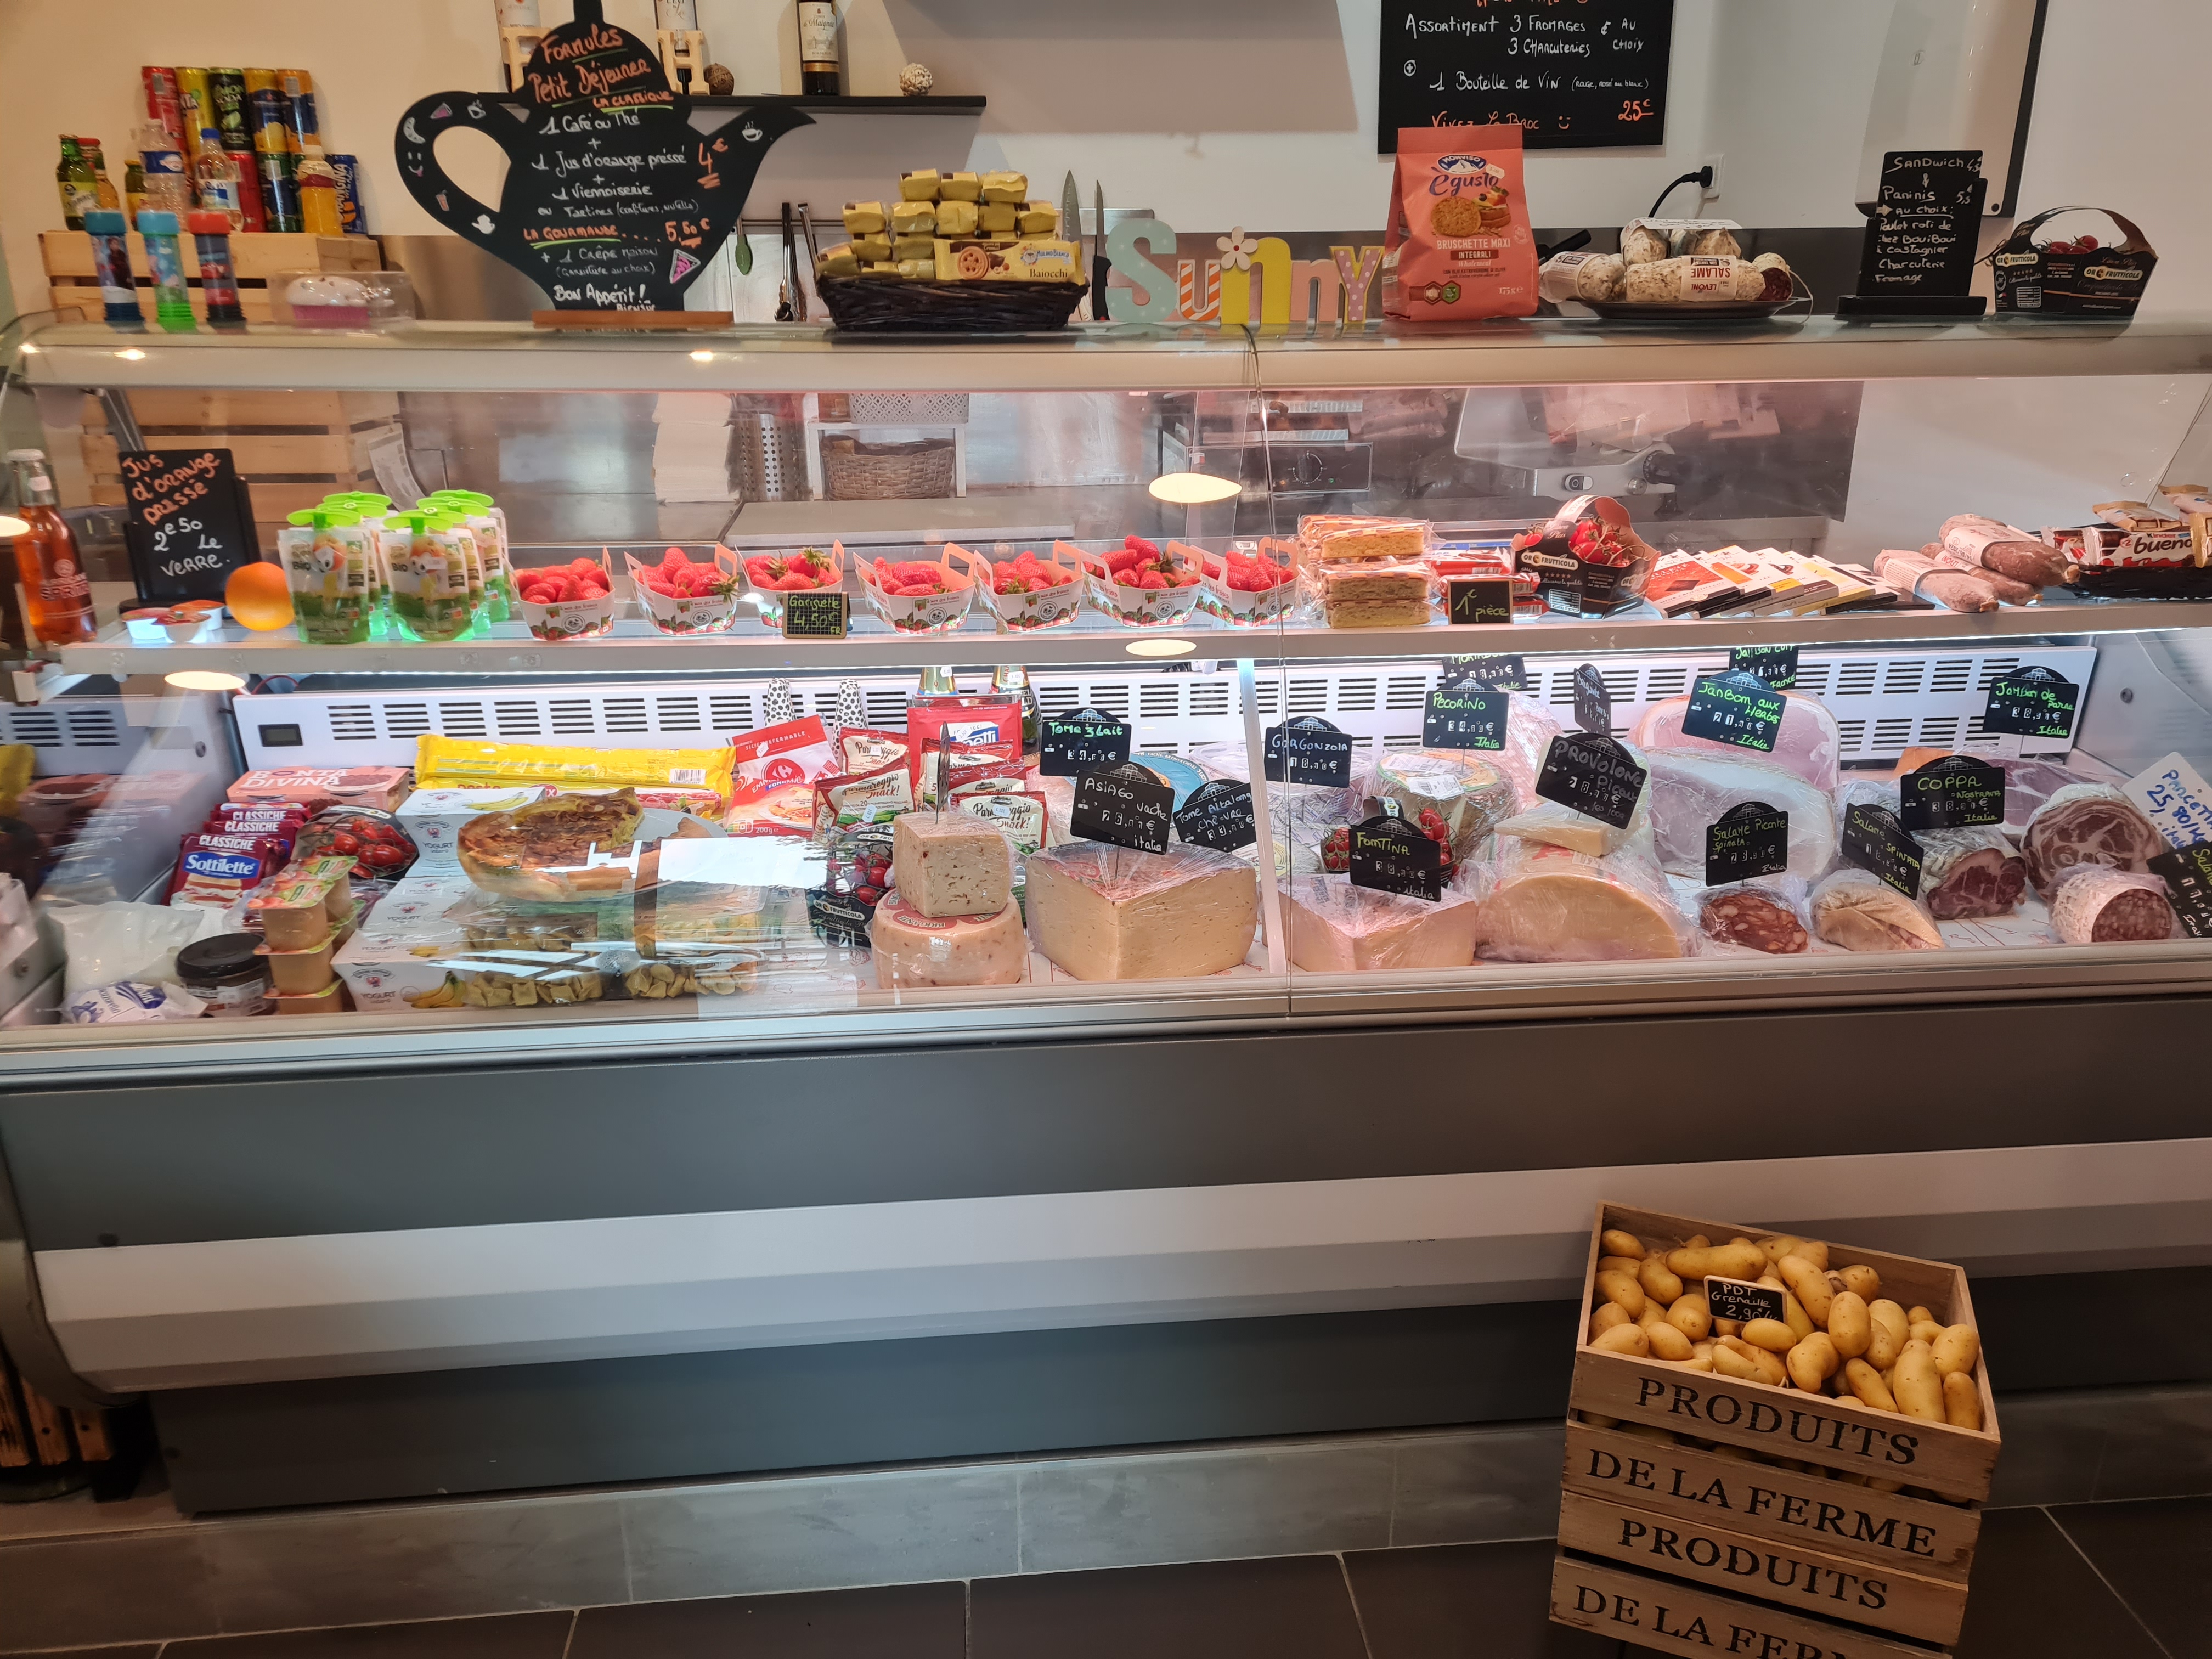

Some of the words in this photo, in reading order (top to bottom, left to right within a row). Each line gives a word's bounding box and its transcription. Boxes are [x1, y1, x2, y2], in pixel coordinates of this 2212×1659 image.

[1510, 14, 1522, 33] 3
[1507, 37, 1519, 55] 3
[657, 29, 710, 95] H
[528, 71, 572, 104] Petit
[1430, 71, 1445, 92] 1
[1456, 70, 1509, 91] Bouteille
[1515, 74, 1530, 91] de
[539, 116, 561, 135] 1
[562, 114, 593, 133] Café
[595, 120, 612, 129] ou
[614, 106, 641, 127] Thé
[531, 153, 549, 171] 1
[555, 150, 580, 178] Jus
[1442, 154, 1482, 164] MONVISO
[552, 187, 570, 200] 1
[1882, 185, 1936, 204] Paninis
[1938, 220, 1952, 231] de
[1436, 239, 1489, 250] BRUSCHETTE
[1490, 238, 1511, 249] MAXI
[1458, 250, 1492, 259] INTEGRALI
[1029, 268, 1068, 279] Baiocchi
[1690, 267, 1731, 278] SALAME
[1691, 283, 1717, 291] LEVONI
[122, 454, 164, 479] Jus
[1541, 556, 1576, 568] FRUTTICOLA
[1476, 605, 1509, 624] pièce
[2041, 688, 2058, 701] de
[1758, 698, 1781, 711] aux
[241, 776, 342, 788] DIVINA
[1917, 775, 1982, 791] COPPA
[224, 821, 280, 833] CLASSICHE
[198, 834, 257, 851] CLASSICHE
[422, 841, 454, 849] YOGURT
[185, 853, 256, 876] Sottilette
[830, 906, 864, 919] FRUTTICOLA
[360, 991, 397, 1000] YOGURT
[1722, 1282, 1758, 1296] PDT
[1636, 1377, 1920, 1469] PRODUITS
[1587, 1448, 1656, 1492] DE
[1667, 1466, 1734, 1511] LA
[1743, 1485, 1938, 1559] FERME
[1617, 1517, 1888, 1611] PRODUITS
[1573, 1584, 1641, 1627] DE
[1651, 1604, 1720, 1647] LA
[1728, 1623, 1851, 1659] FER
